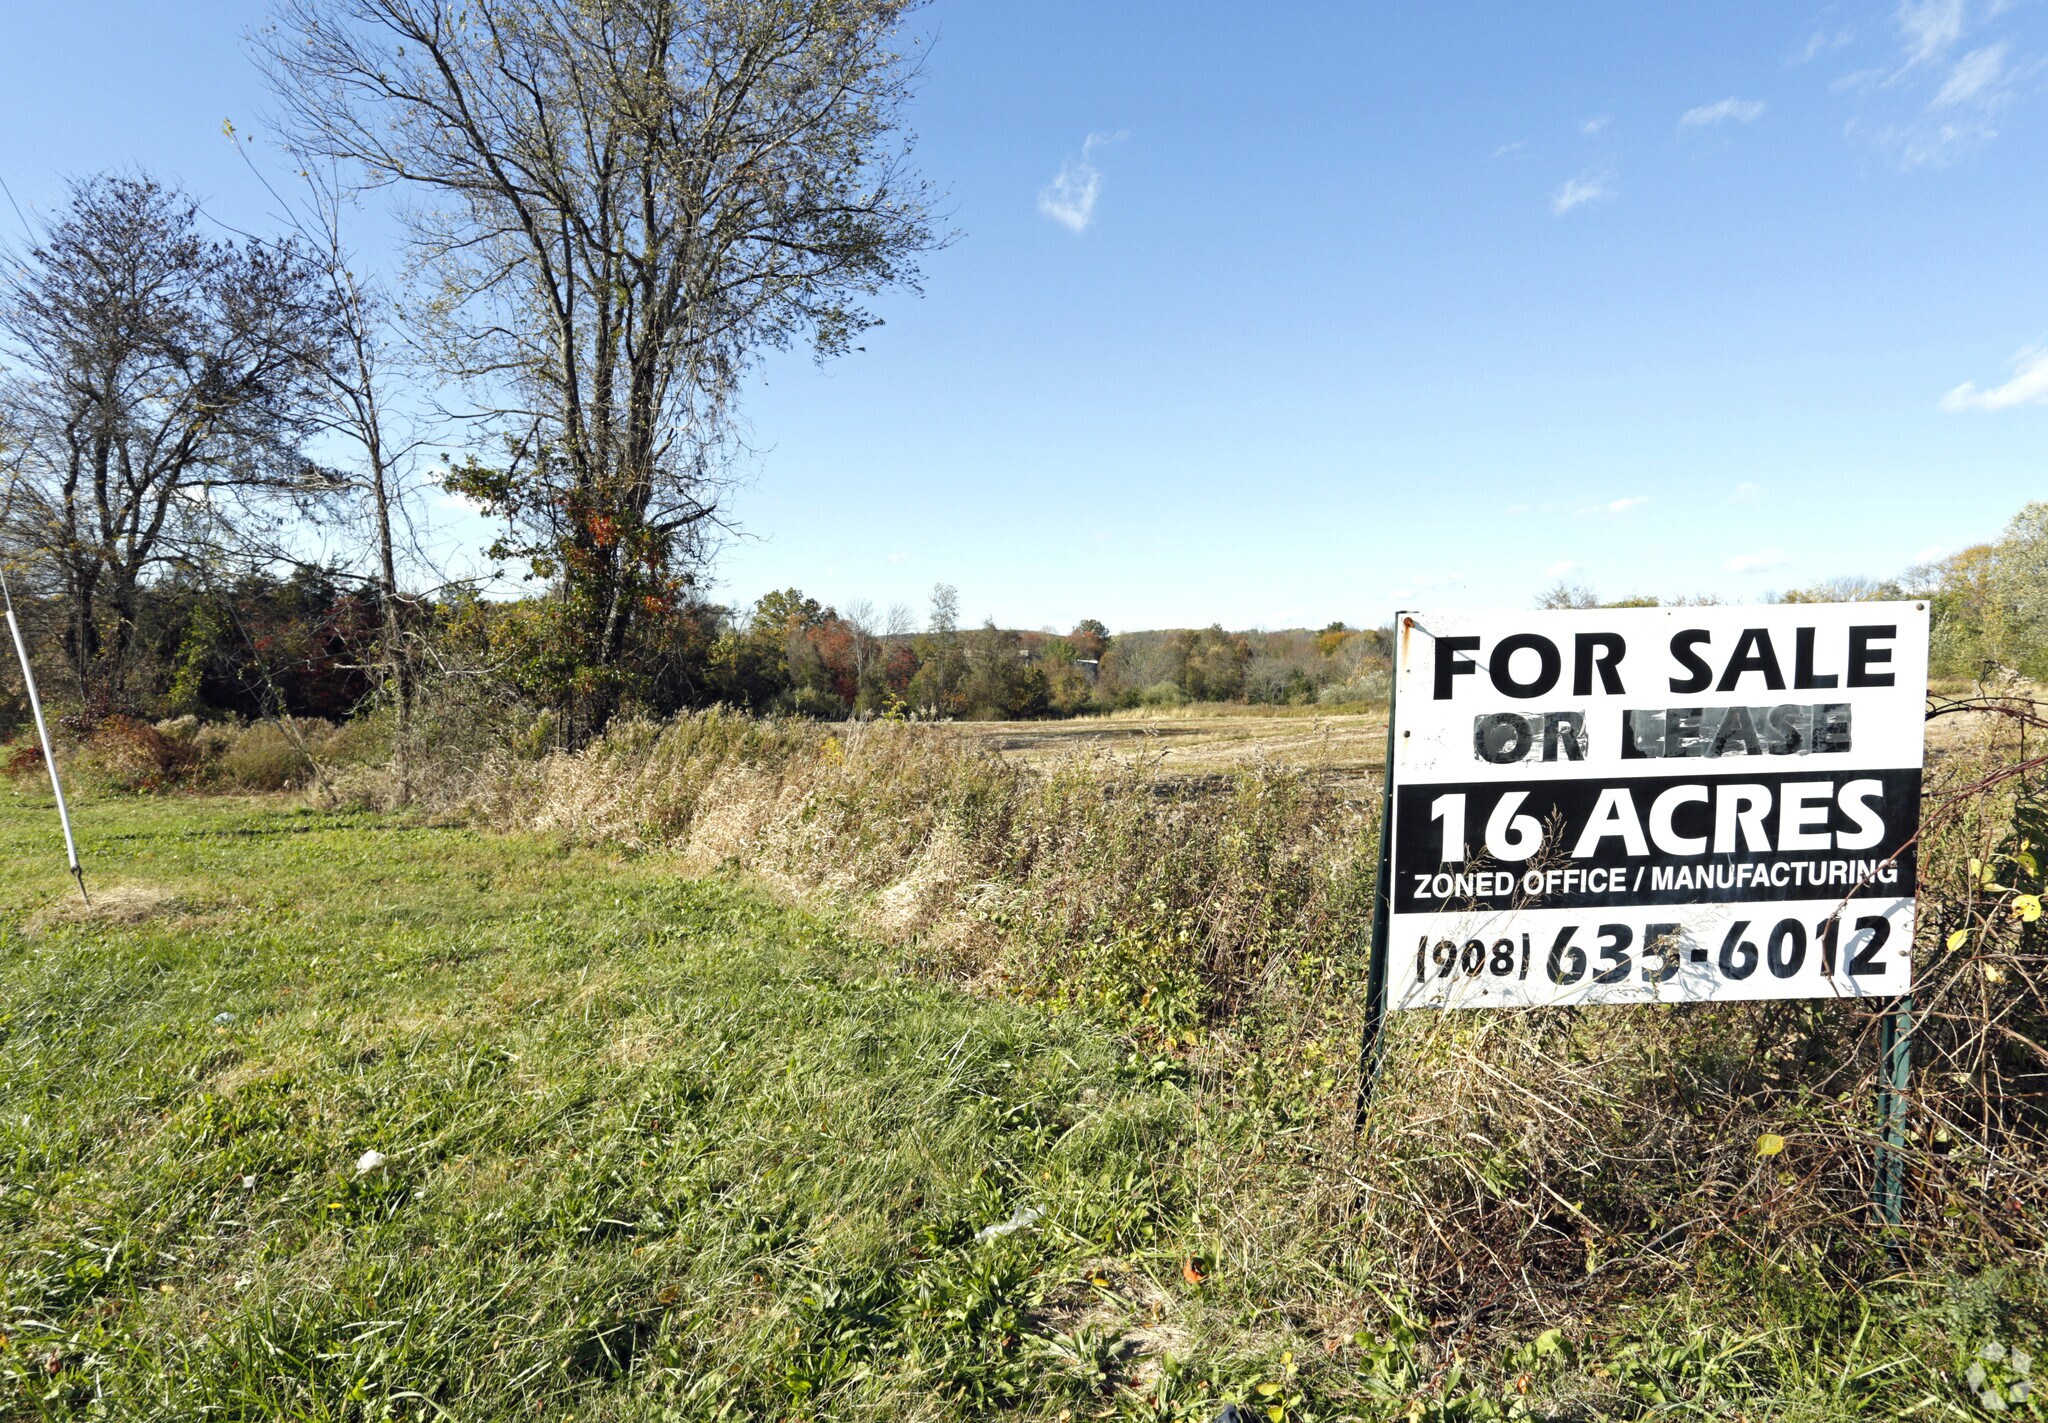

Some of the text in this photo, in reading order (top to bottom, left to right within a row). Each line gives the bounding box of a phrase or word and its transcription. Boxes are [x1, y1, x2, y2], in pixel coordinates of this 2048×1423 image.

[1434, 625, 1897, 700] FOR SALE
[1473, 703, 1852, 764] OR LEASE
[1430, 780, 1885, 862] 16 ACRES
[1414, 873, 1513, 899] ZONED
[1524, 867, 1626, 894] OFFICE
[1651, 859, 1898, 890] MANUFACTURING
[1416, 915, 1891, 986] (908) 635-6012
